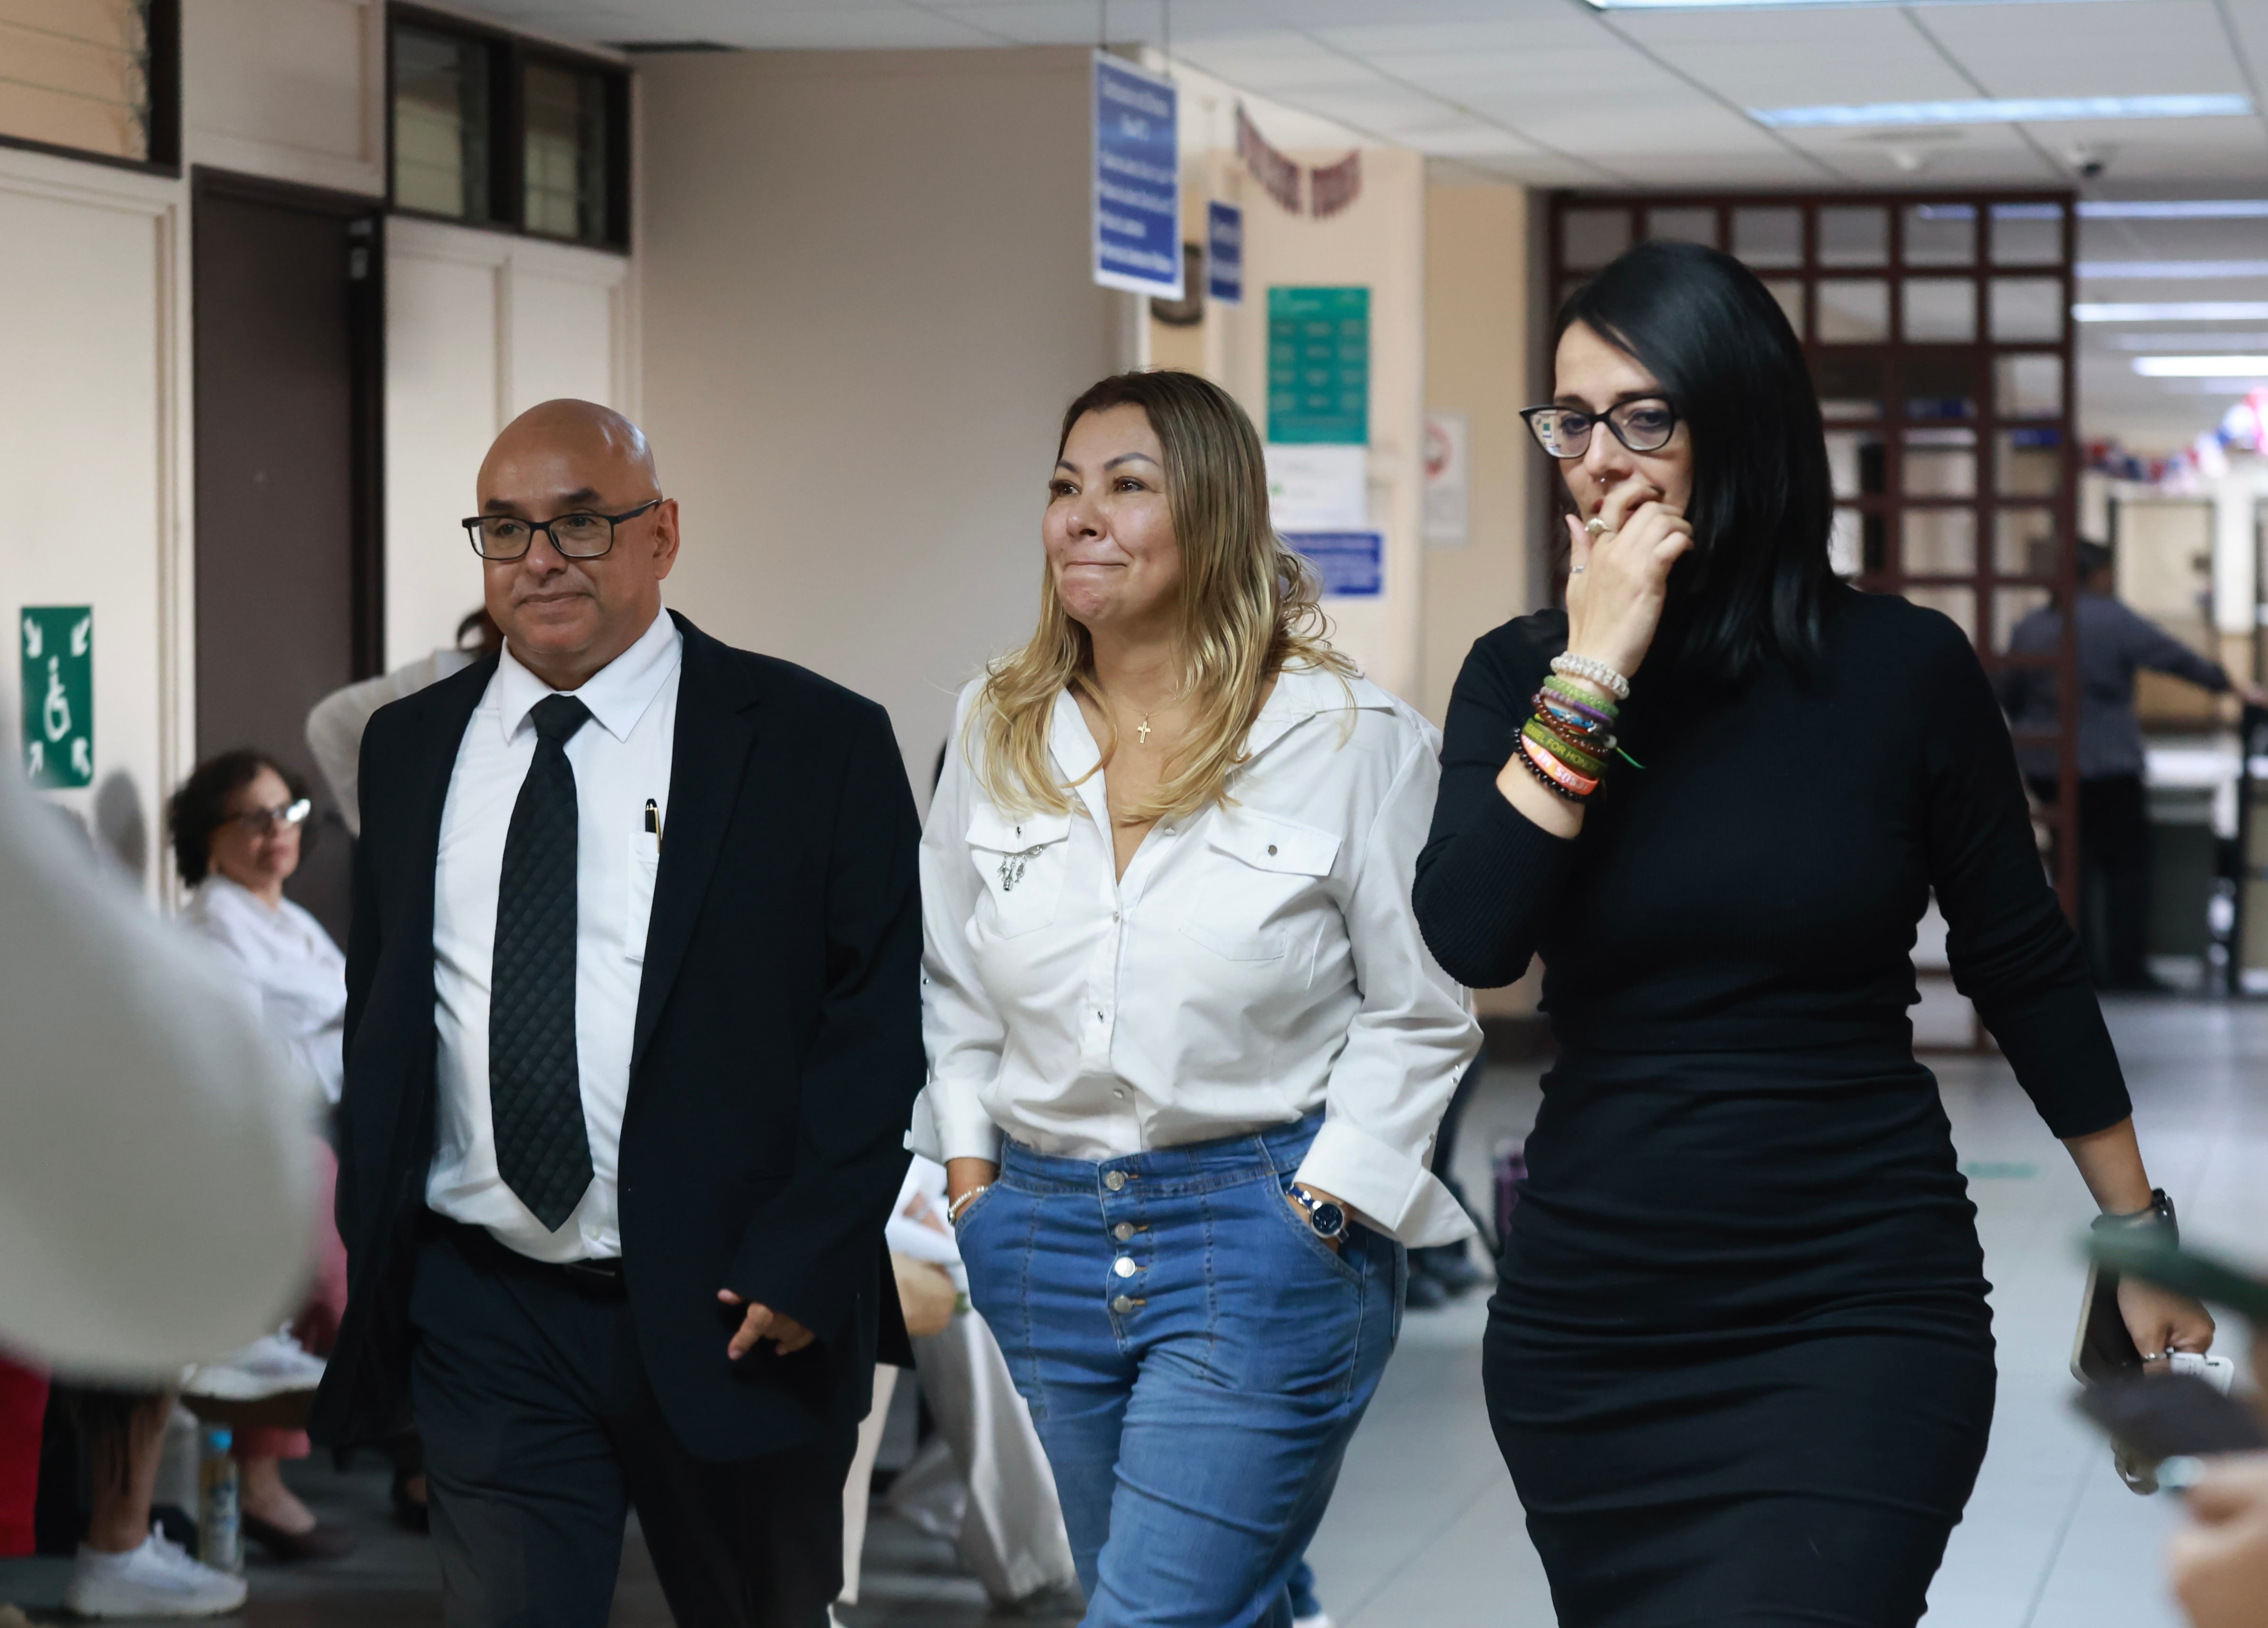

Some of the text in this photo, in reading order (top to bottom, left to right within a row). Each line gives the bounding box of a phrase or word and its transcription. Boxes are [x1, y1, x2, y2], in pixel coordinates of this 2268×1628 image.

[1524, 723, 1545, 743] ESSEL
[1546, 738, 1566, 755] FOR
[1537, 749, 1555, 768] ME
